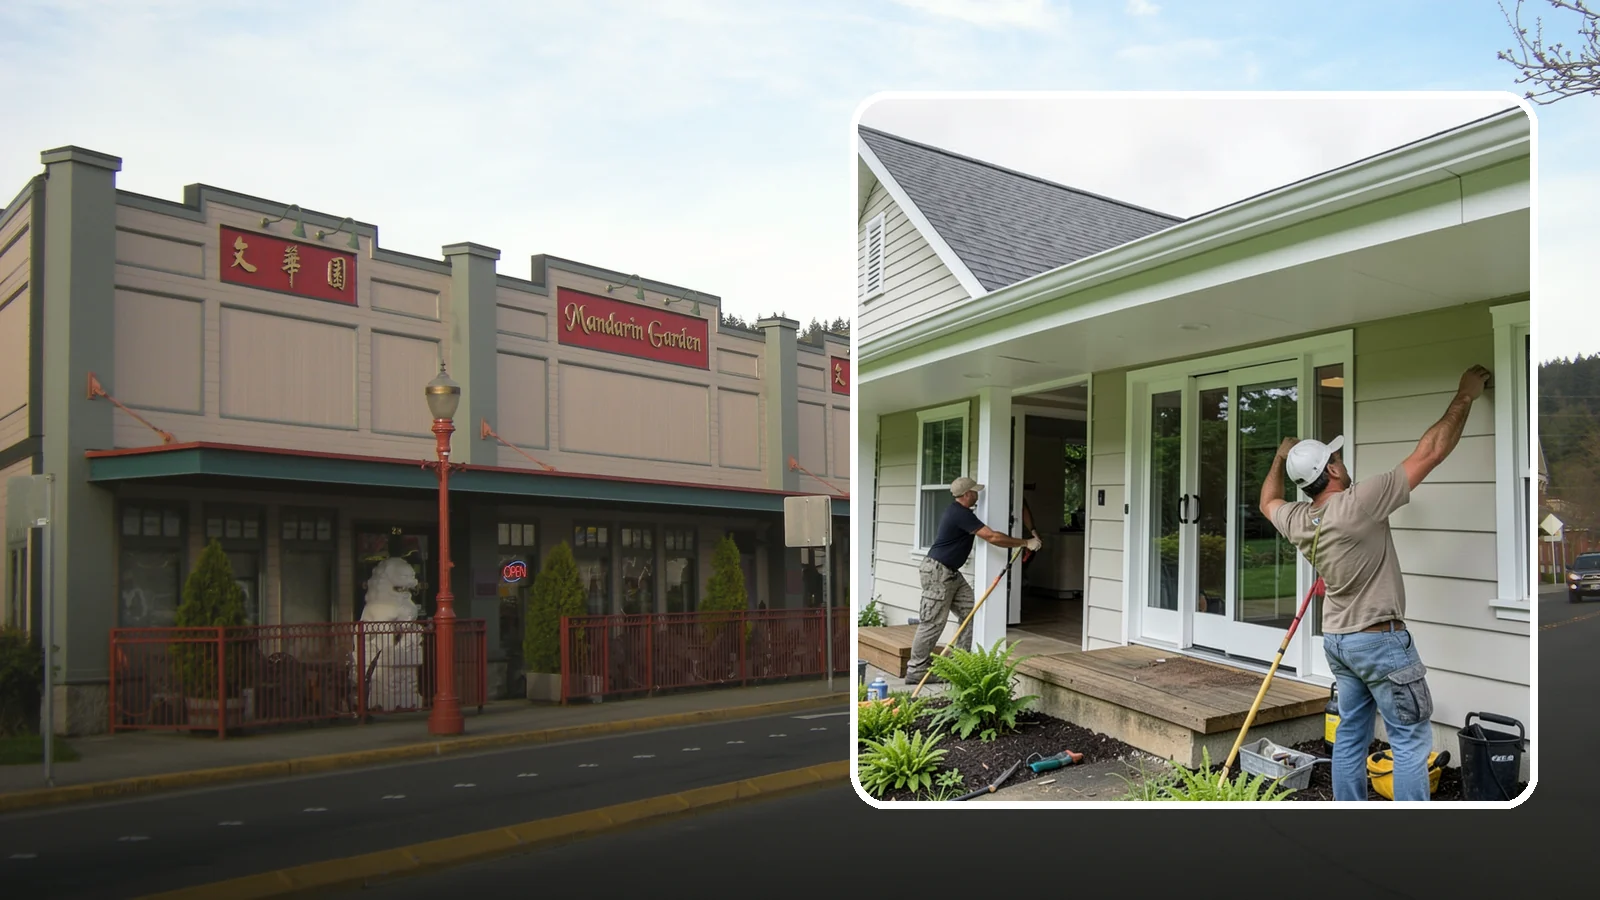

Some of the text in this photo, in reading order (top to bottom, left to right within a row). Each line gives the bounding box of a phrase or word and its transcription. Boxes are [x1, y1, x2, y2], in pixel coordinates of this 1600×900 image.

[230, 235, 346, 291] 文華園
[564, 302, 702, 352] Mandarin Garden
[503, 565, 527, 578] OPEN
